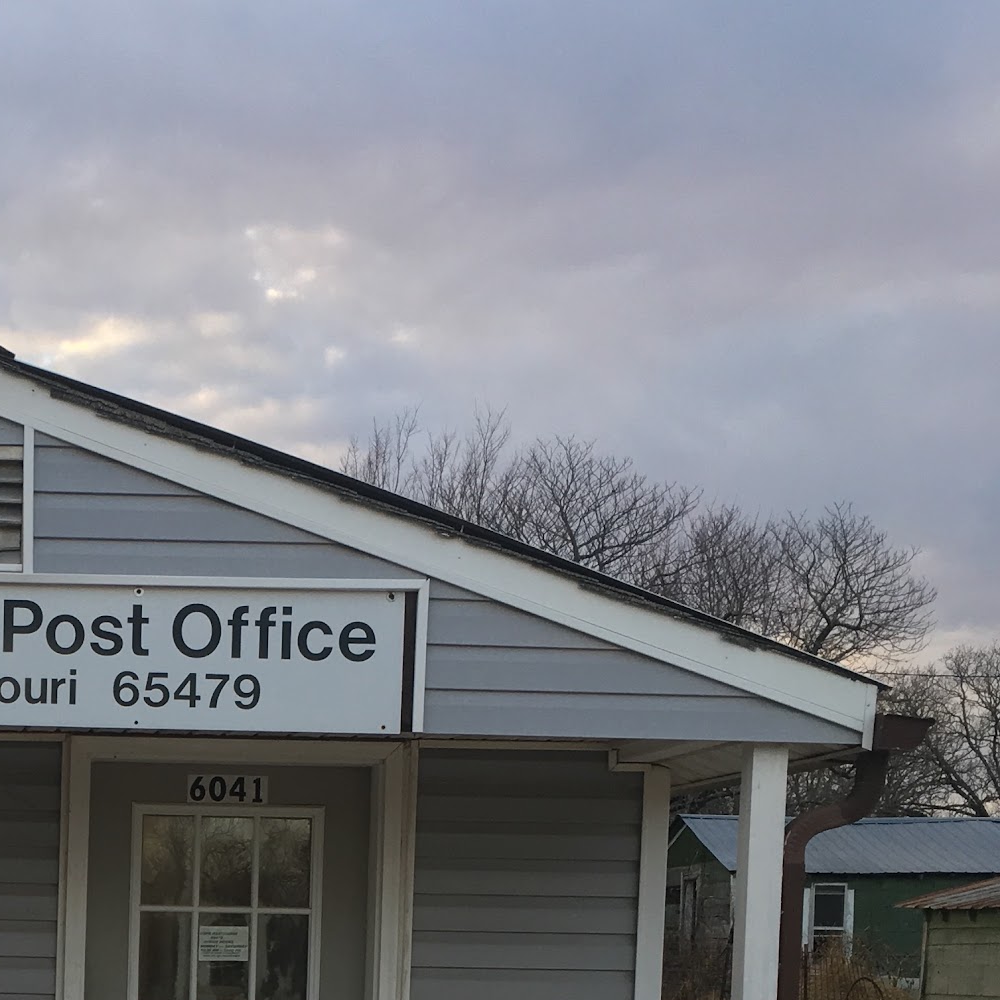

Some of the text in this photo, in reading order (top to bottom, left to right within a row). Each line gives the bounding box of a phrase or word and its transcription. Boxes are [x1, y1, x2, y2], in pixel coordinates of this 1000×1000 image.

[2, 599, 150, 657] Post
[172, 603, 377, 663] Office
[112, 670, 262, 710] 65479
[188, 775, 265, 803] 6041
